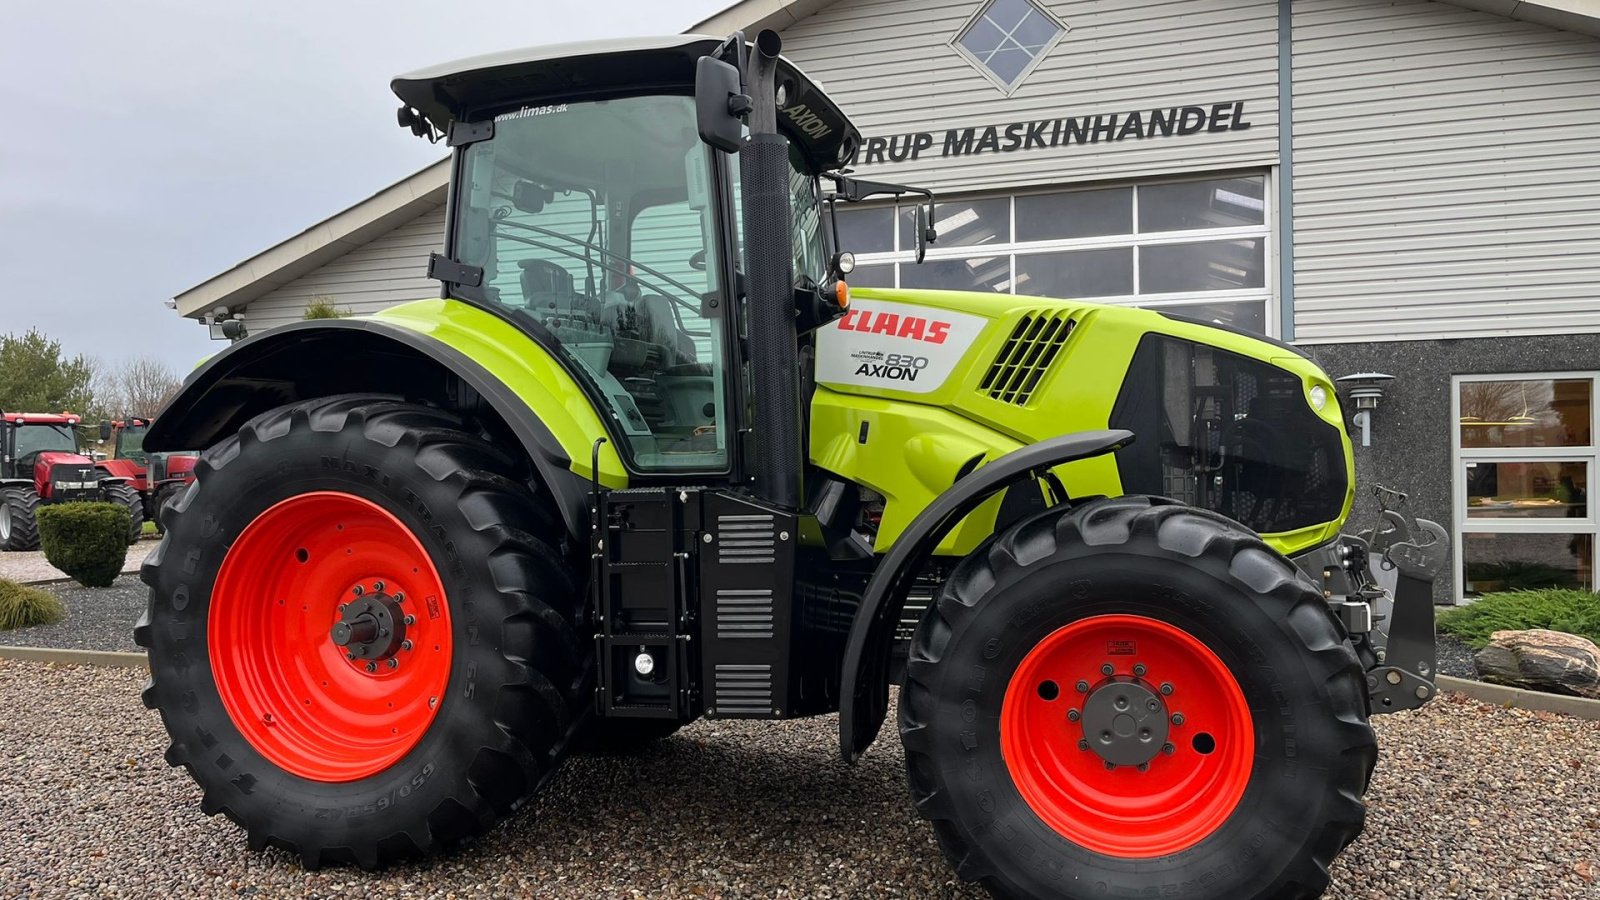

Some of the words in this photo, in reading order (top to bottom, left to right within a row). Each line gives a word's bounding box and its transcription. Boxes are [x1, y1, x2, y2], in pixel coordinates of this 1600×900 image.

[494, 103, 568, 122] www.limas.dk
[786, 104, 832, 139] AXION
[942, 102, 1251, 157] MASKINHANDEL
[838, 310, 951, 344] CLAAS
[855, 363, 918, 381] AXION
[885, 353, 929, 370] 830
[320, 455, 391, 487] MAXI
